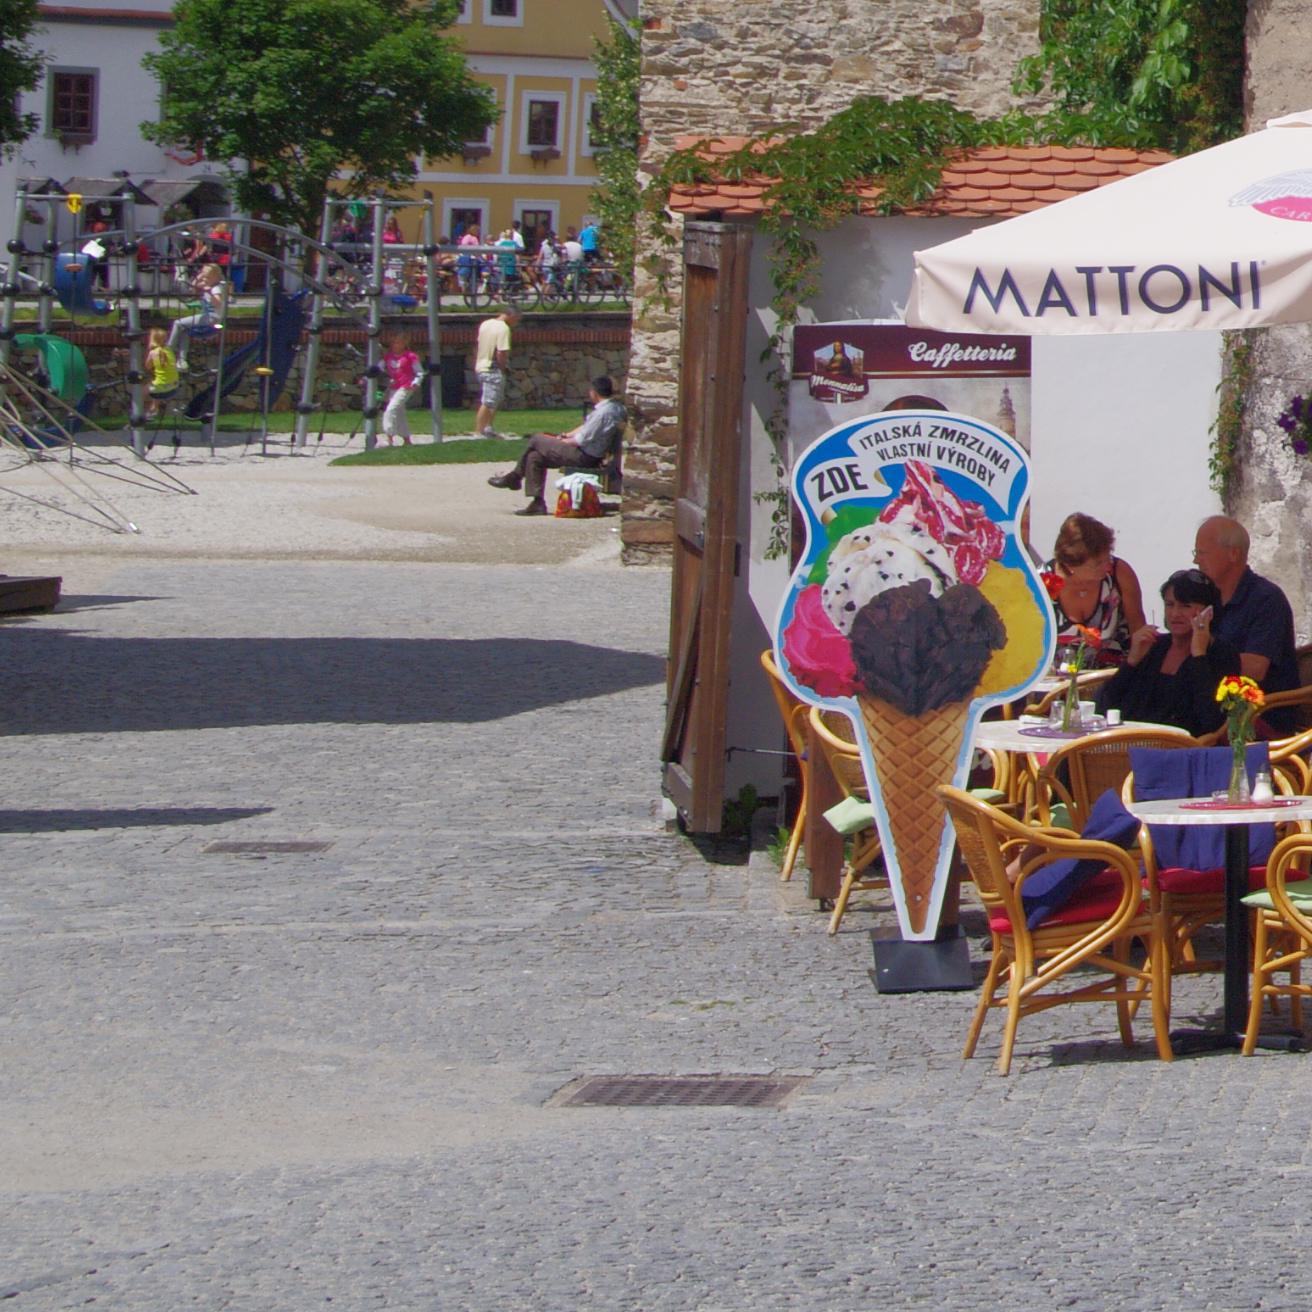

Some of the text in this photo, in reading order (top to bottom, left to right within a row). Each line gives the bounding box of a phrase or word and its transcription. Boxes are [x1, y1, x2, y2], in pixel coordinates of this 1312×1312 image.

[962, 261, 1263, 318] MATTONI
[908, 341, 1017, 368] Caffetteria
[859, 421, 1011, 474] ITALSKÁ ZMRZLINA
[876, 441, 996, 487] VLASTNÍ VÝROBY
[811, 464, 869, 503] ZDE
